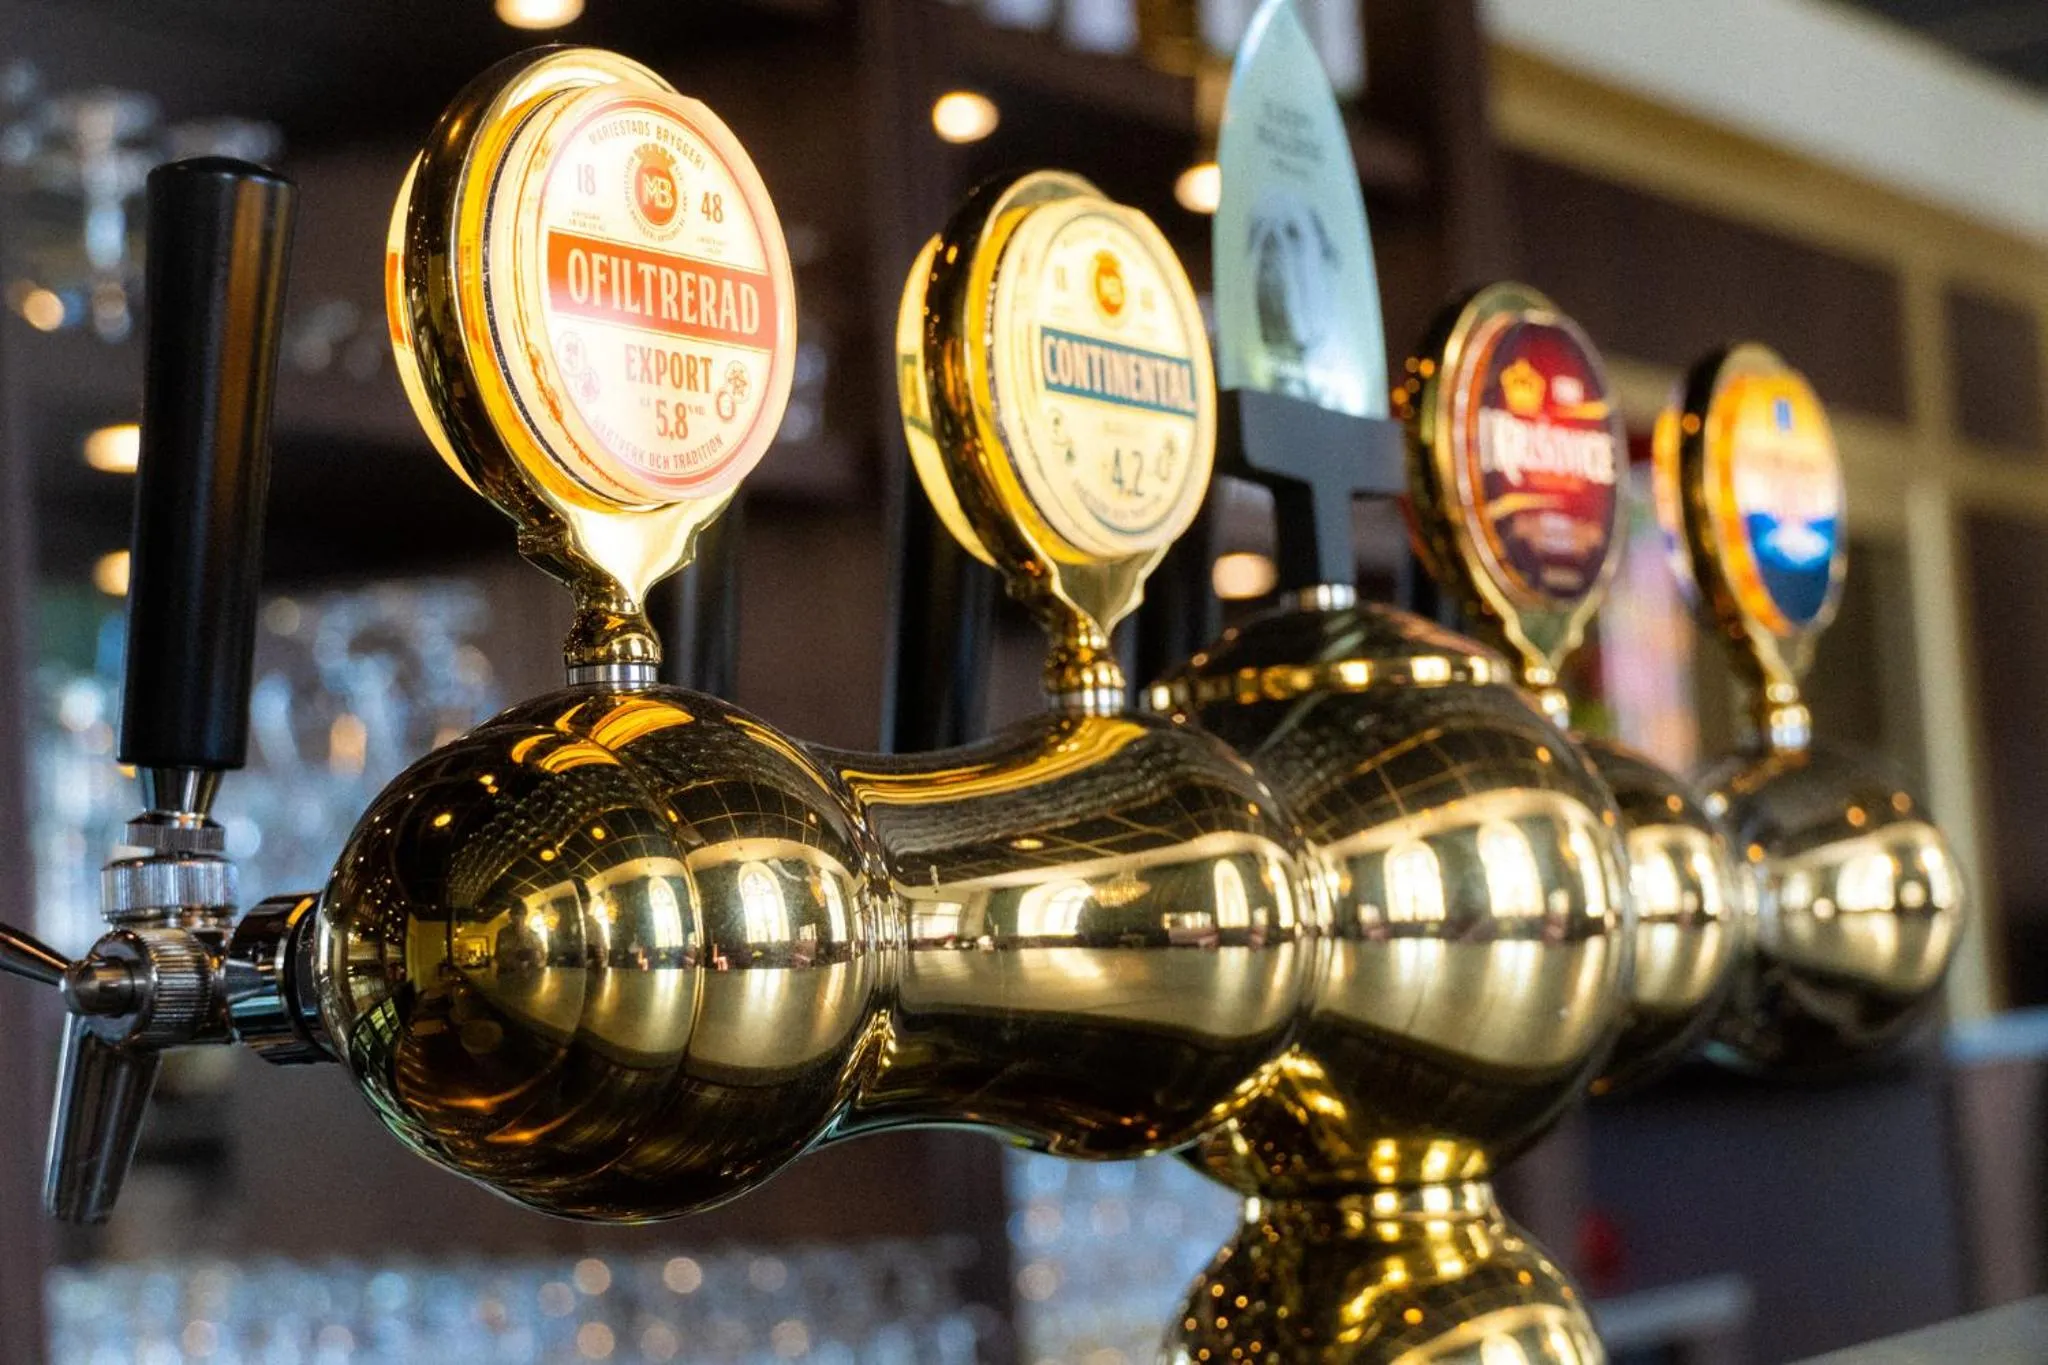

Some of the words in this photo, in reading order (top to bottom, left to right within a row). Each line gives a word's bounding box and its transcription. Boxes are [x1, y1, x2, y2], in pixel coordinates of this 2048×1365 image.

[655, 124, 707, 173] BRYGGERI
[576, 163, 597, 197] 18
[701, 190, 725, 225] 48
[567, 247, 760, 335] OFILTRERAD
[624, 343, 713, 394] EXPORT
[1043, 335, 1196, 410] CONTINENTAL
[649, 452, 671, 471] OCH
[672, 432, 724, 471] TRADITION
